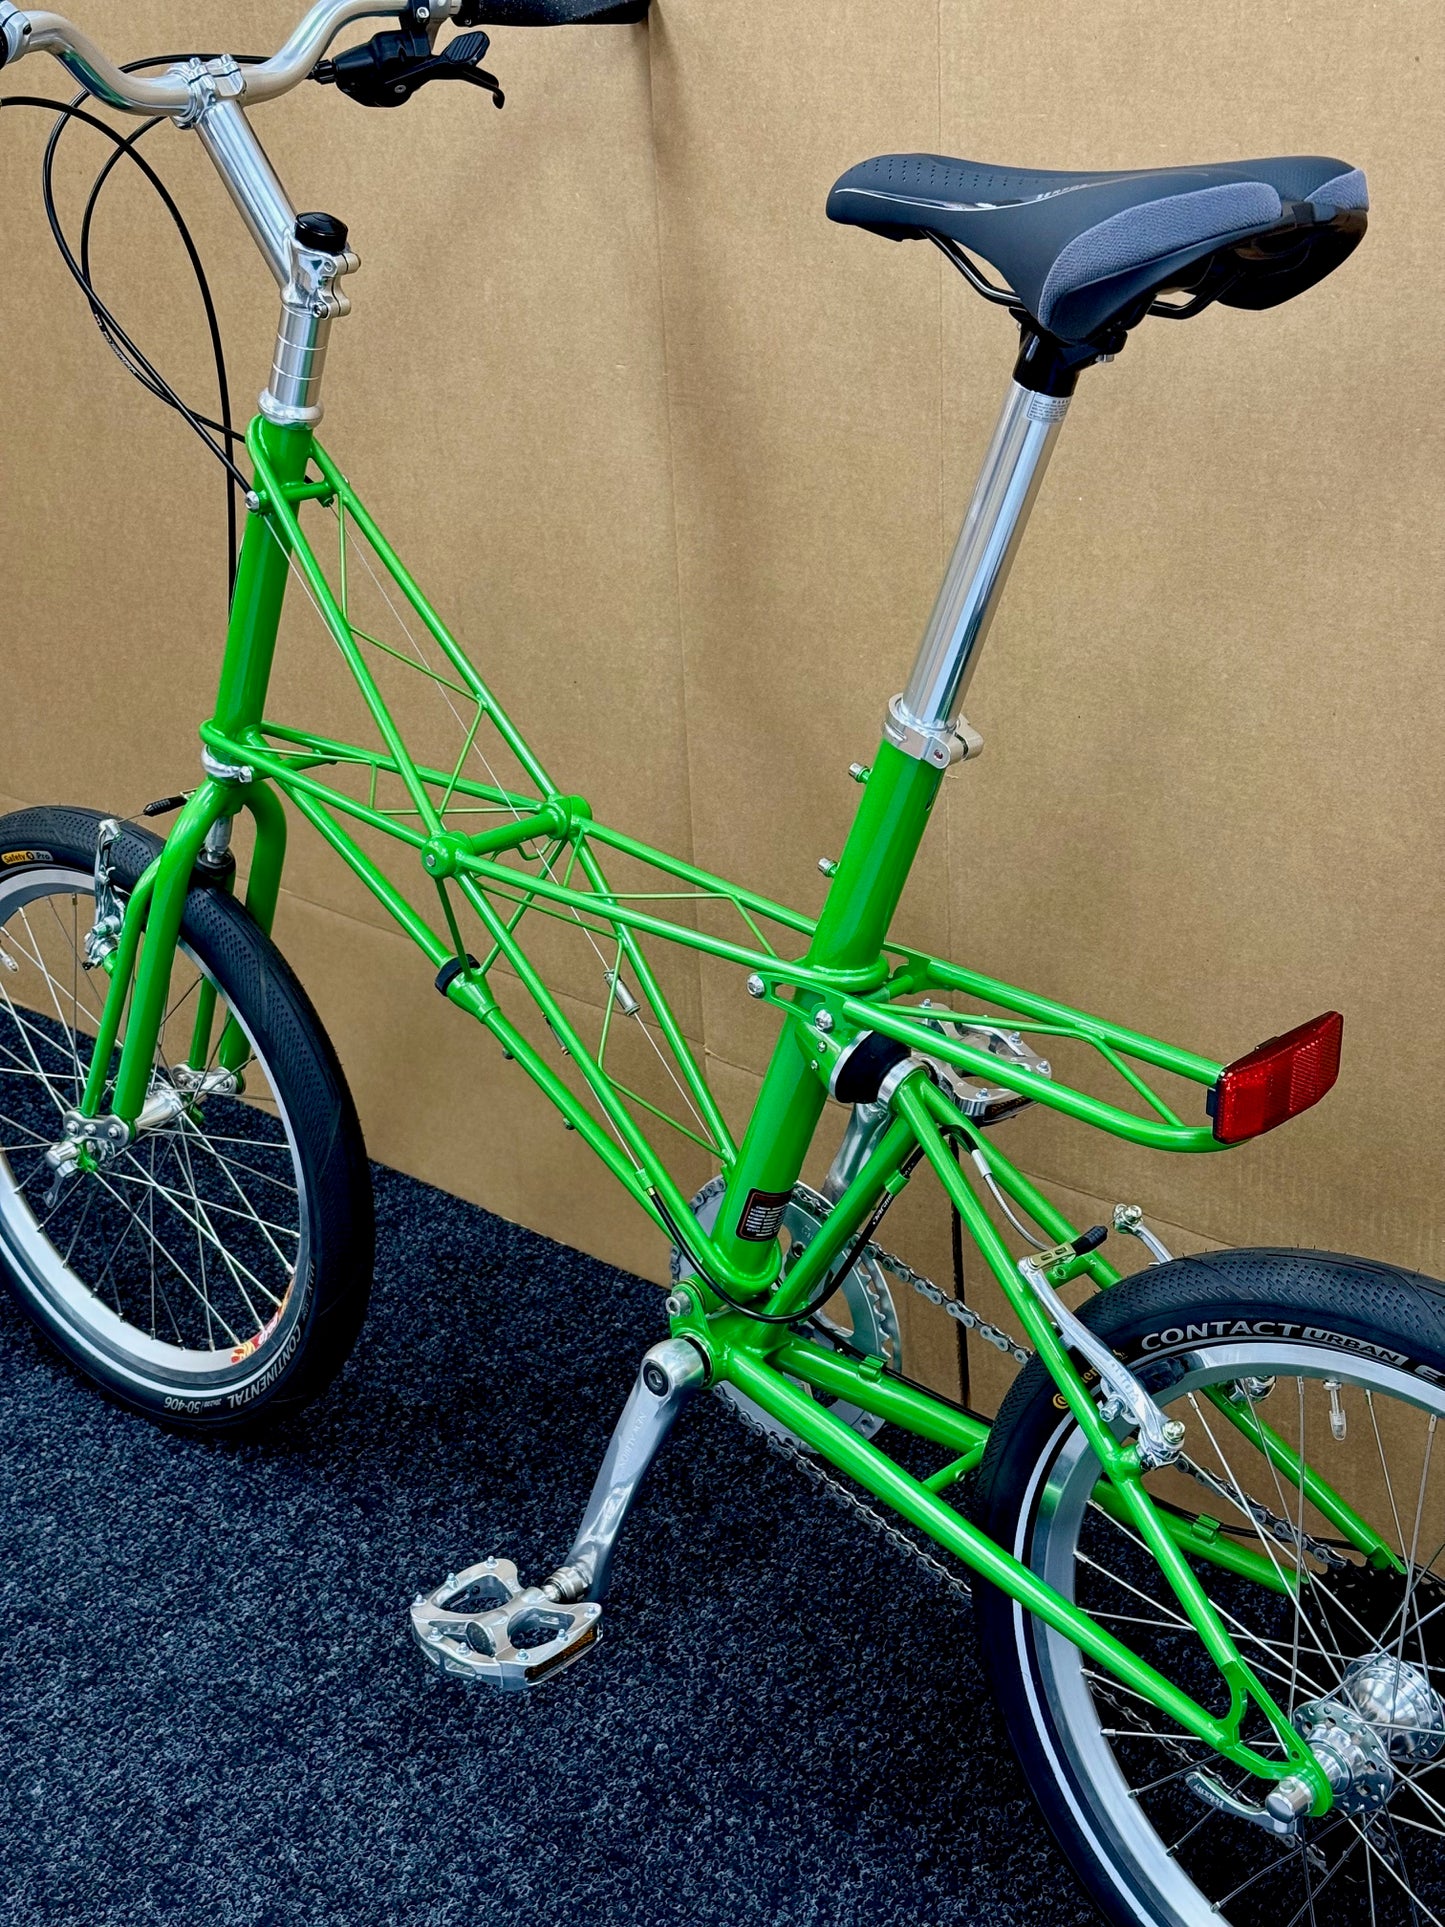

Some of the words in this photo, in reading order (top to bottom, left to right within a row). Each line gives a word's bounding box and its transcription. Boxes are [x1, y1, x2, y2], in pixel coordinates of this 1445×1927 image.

[4, 853, 26, 864] Safety
[36, 852, 51, 861] Pro
[1141, 1321, 1301, 1351] CONTACT
[1307, 1328, 1400, 1364] URBAN
[227, 1324, 301, 1409] CONTINENTAL
[163, 1396, 201, 1414] 50-406
